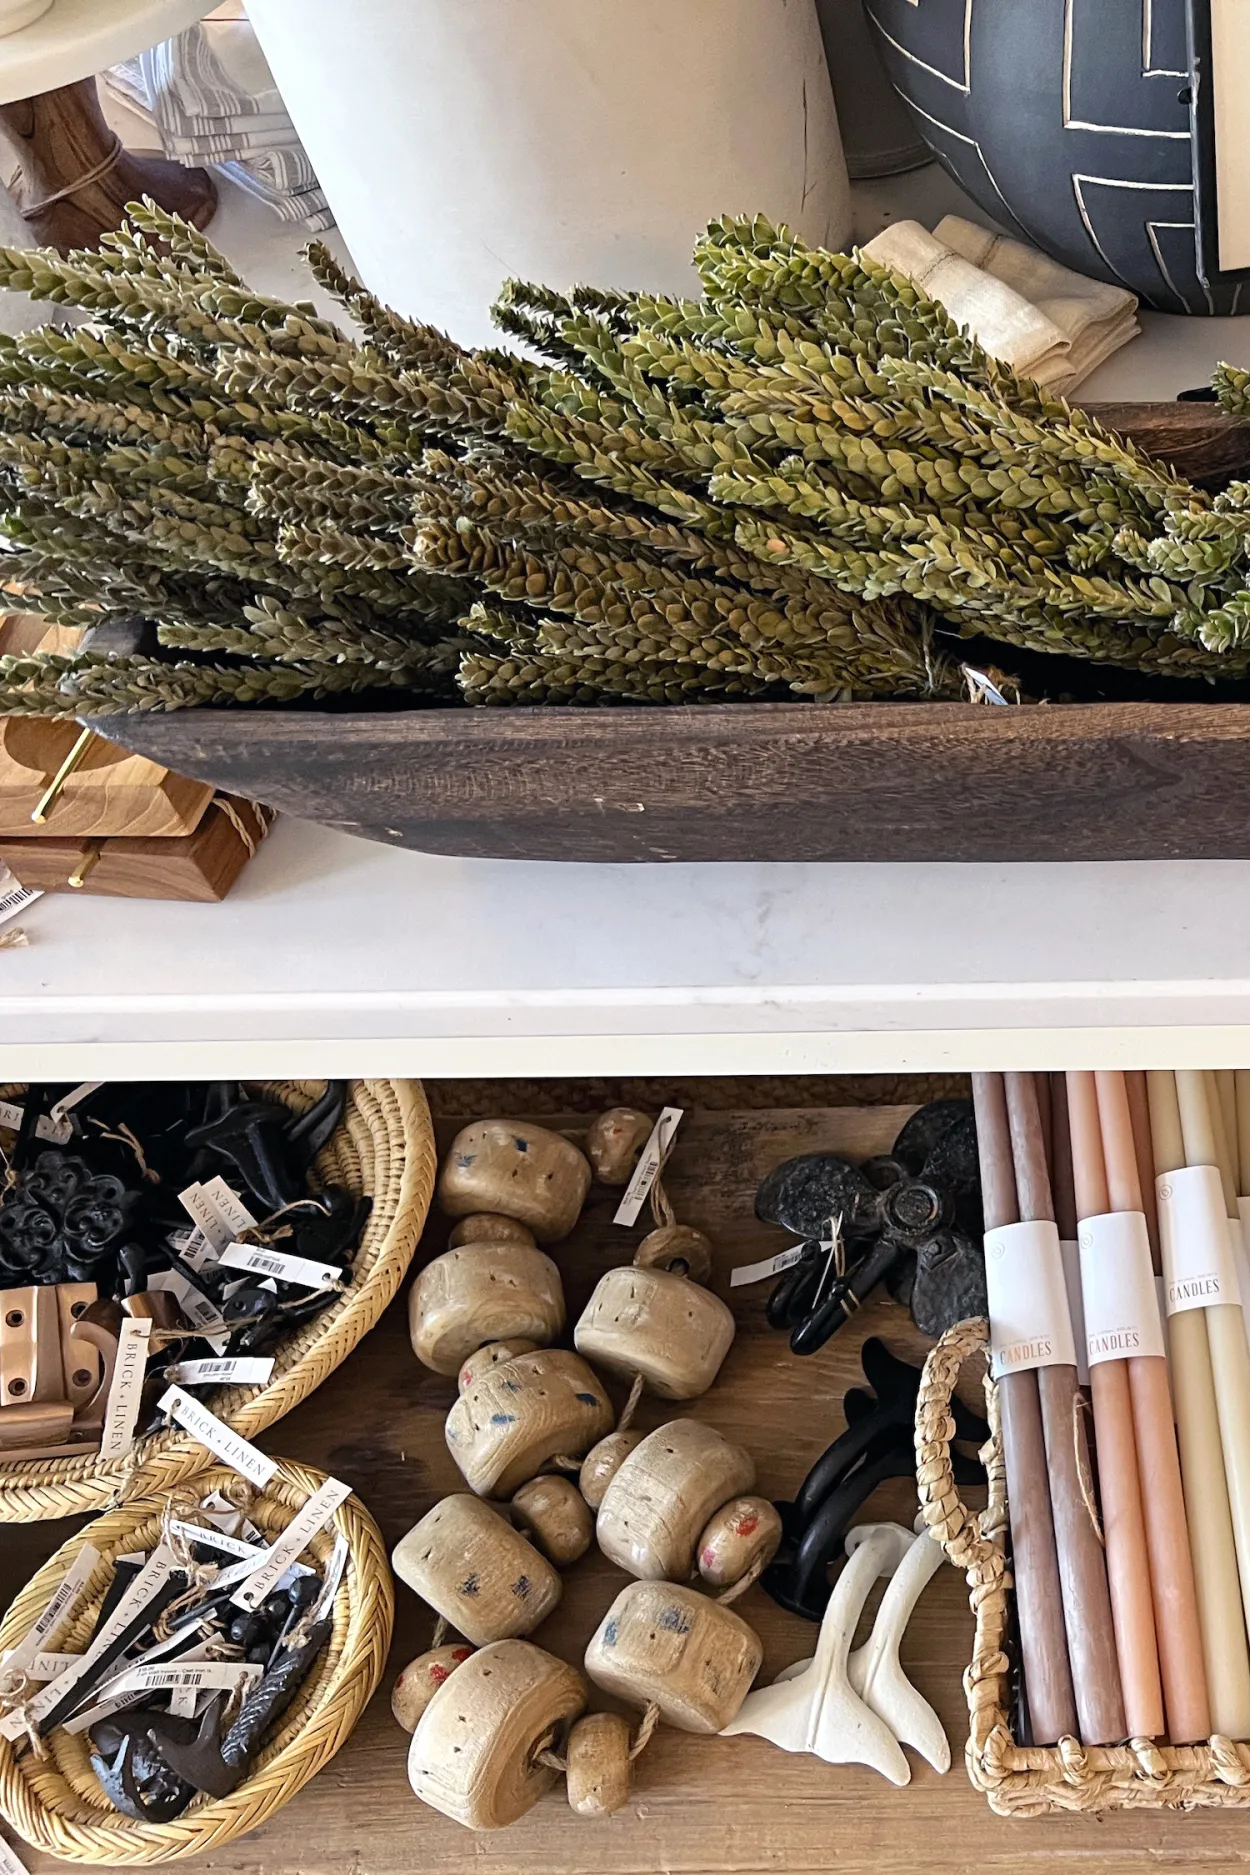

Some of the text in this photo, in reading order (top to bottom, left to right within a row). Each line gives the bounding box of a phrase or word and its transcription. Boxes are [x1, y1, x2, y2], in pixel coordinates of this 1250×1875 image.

[190, 1192, 218, 1230] LINEN
[212, 1190, 246, 1229] LINEN
[1169, 1278, 1220, 1302] CANDLES
[1000, 1341, 1052, 1365] CANDLES
[1088, 1333, 1140, 1356] CANDLES
[120, 1343, 138, 1389] BRICK
[110, 1404, 128, 1450] LINEN
[181, 1405, 217, 1439] BRICK
[224, 1442, 266, 1476] LINEN
[200, 1531, 246, 1554] BRICK
[254, 1545, 295, 1590] BRICK
[300, 1489, 340, 1534] LINEN
[128, 1560, 167, 1609] BRICK
[28, 1660, 69, 1672] LIN
[10, 1687, 61, 1728] LINN
